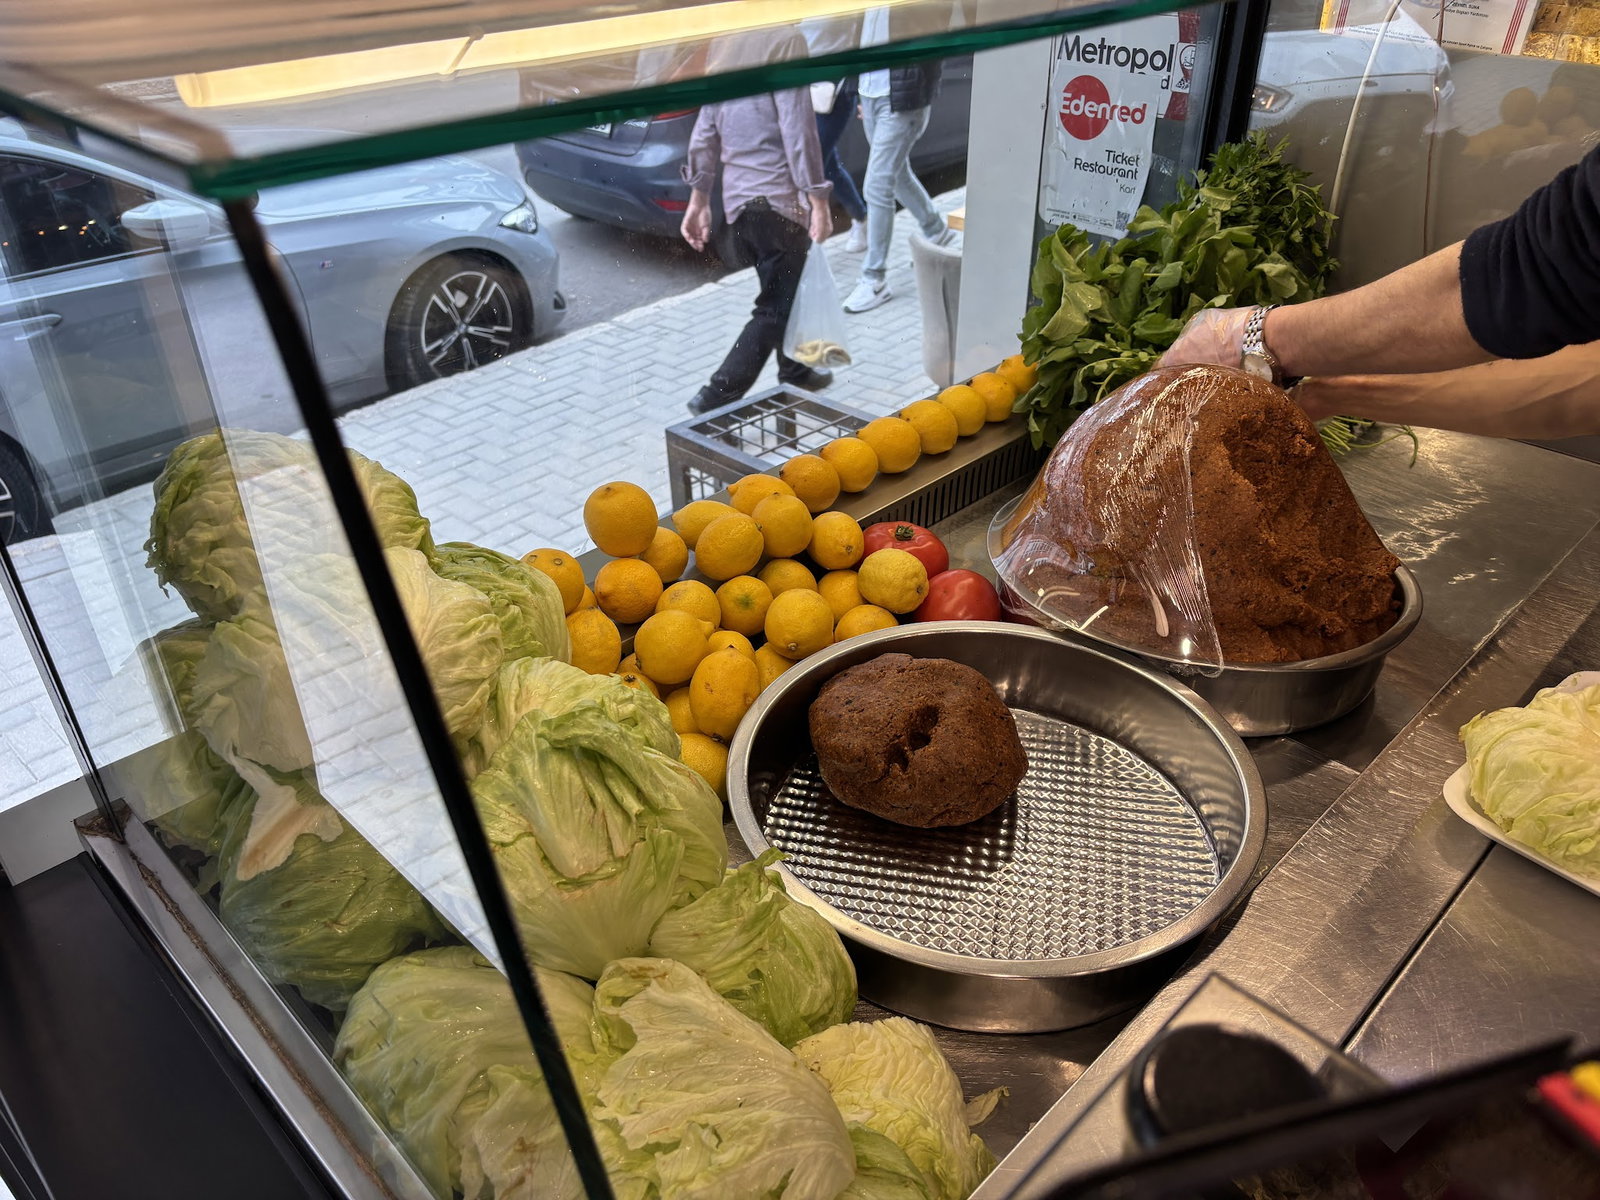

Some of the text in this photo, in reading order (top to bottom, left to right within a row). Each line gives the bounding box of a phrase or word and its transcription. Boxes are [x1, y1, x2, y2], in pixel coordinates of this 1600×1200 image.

[1057, 34, 1175, 74] Metropol
[1060, 92, 1147, 125] Edenred
[1073, 157, 1138, 180] Restaurant
[1105, 149, 1140, 167] Ticket
[1119, 184, 1136, 194] Kart
